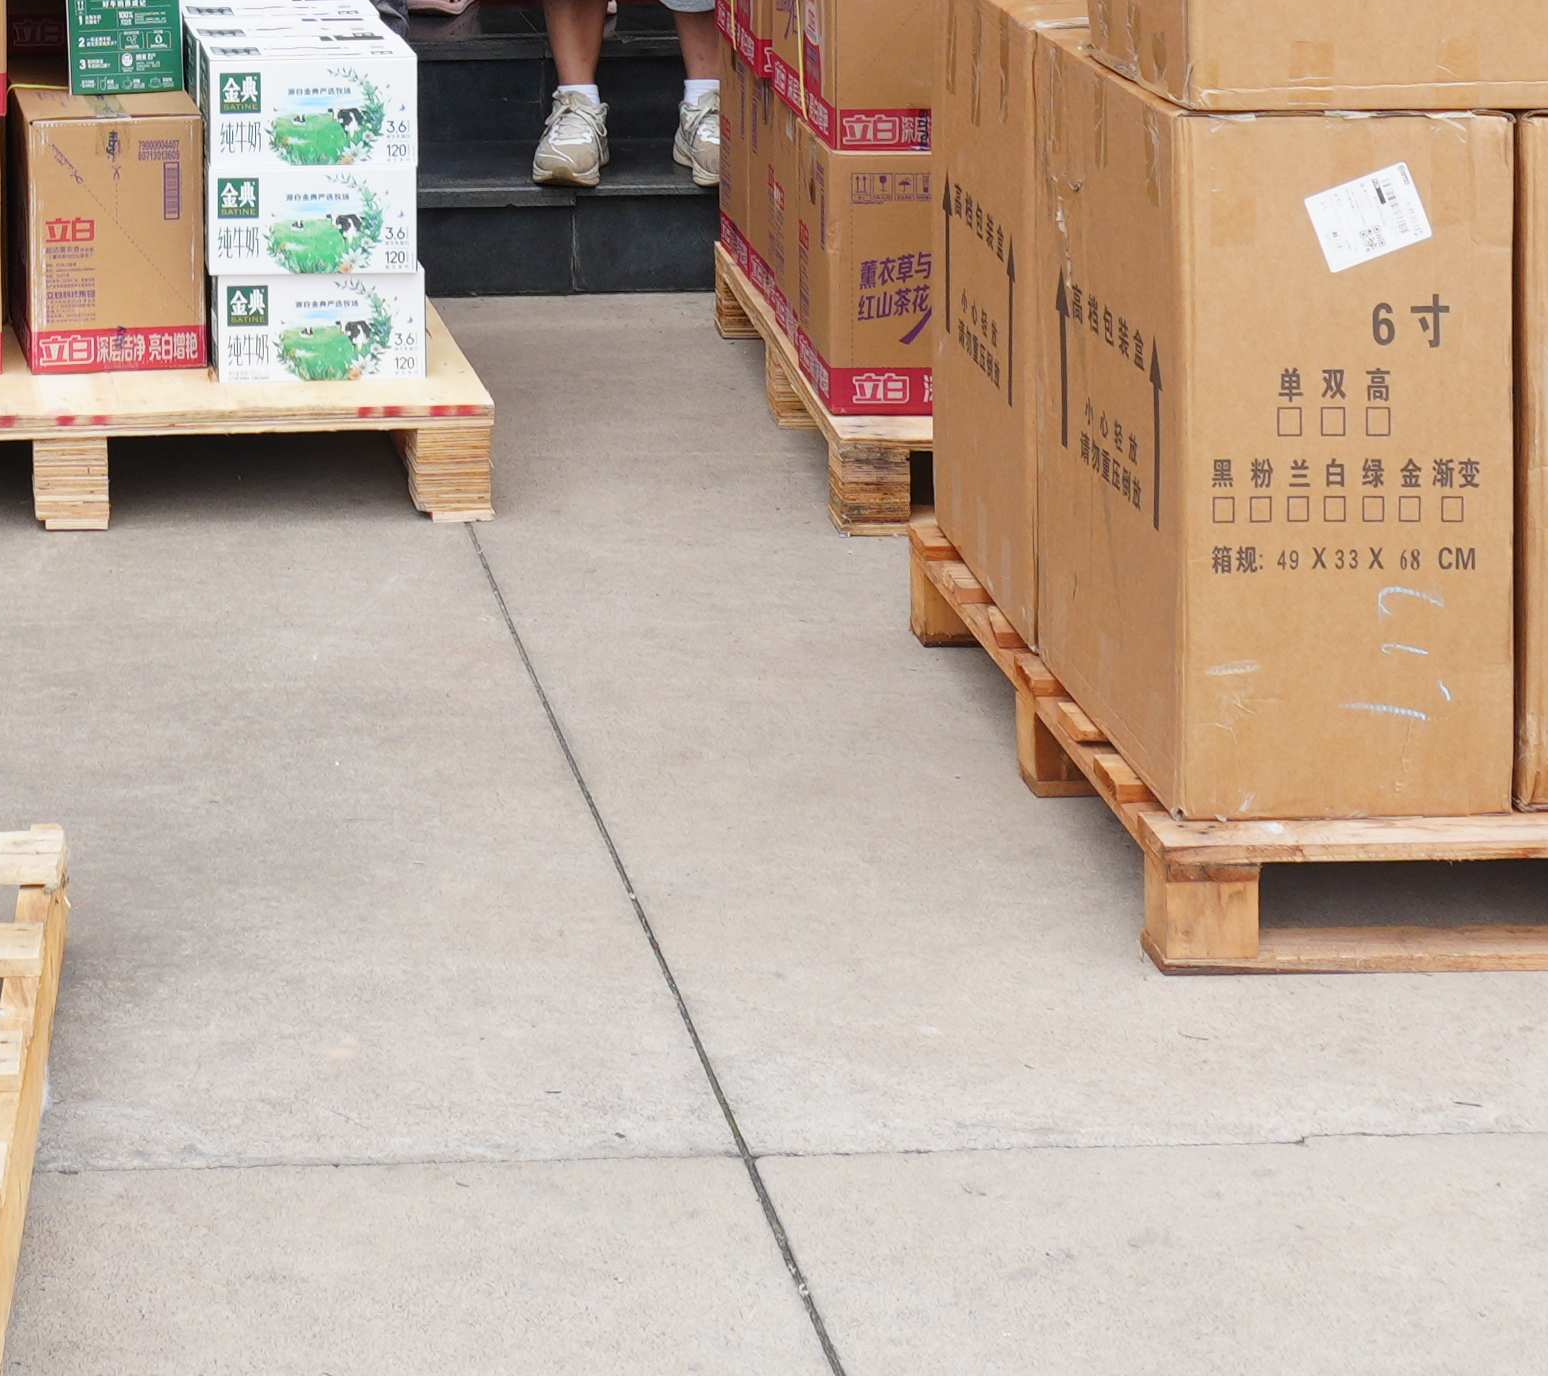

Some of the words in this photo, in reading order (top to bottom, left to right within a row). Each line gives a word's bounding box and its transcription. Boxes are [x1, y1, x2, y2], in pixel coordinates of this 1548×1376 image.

[223, 76, 258, 103] 金典
[220, 121, 261, 153] 纯牛奶
[386, 120, 407, 133] 3.6
[842, 113, 899, 145] 立白
[387, 144, 407, 157] 120
[221, 181, 256, 208] 金典
[46, 217, 95, 242] 立白
[218, 227, 260, 259] 纯牛奶
[385, 227, 406, 240] 3.6
[385, 251, 406, 264] 120
[860, 251, 932, 290] 薰衣草与
[230, 288, 266, 315] 金典
[857, 285, 931, 322] 红山茶花
[1372, 294, 1450, 349] 6寸
[39, 335, 94, 365] 立白
[148, 333, 198, 360] 亮白增艳
[227, 334, 269, 366] 纯牛奶
[394, 332, 415, 345] 3.6
[395, 357, 415, 370] 120
[852, 373, 909, 404] 立白
[1211, 545, 1265, 575] 箱规:
[1277, 548, 1300, 571] 49
[1334, 548, 1359, 571] 33
[1368, 547, 1385, 571] X
[1399, 548, 1421, 571] 68
[1437, 547, 1477, 572] CM
